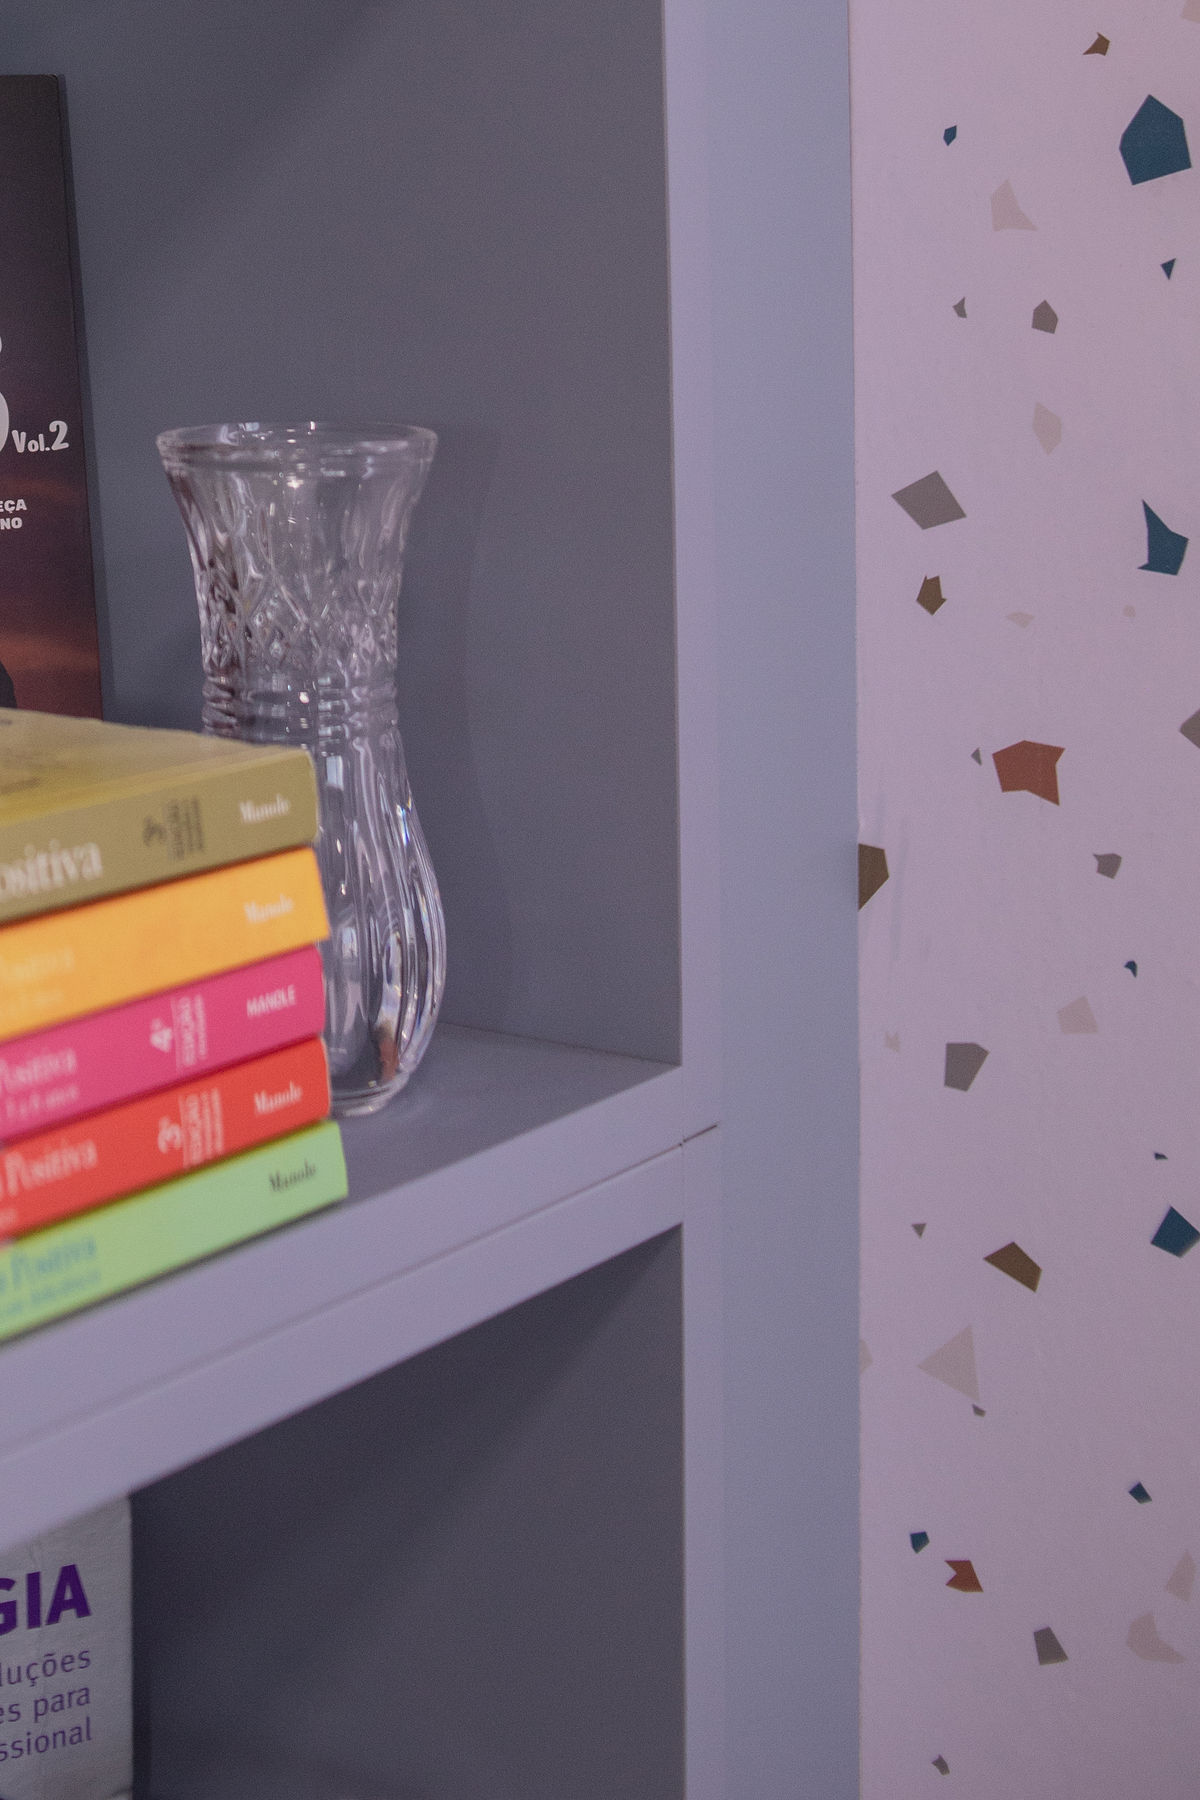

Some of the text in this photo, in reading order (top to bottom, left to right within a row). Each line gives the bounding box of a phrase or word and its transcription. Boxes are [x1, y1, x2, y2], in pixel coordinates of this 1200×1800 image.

[11, 420, 70, 453] Vol.2
[238, 793, 292, 824] Manole
[243, 893, 295, 925] Manole
[246, 984, 296, 1017] MANOLE
[254, 1080, 304, 1116] Manole
[4, 1137, 98, 1198] Positiva
[267, 1157, 318, 1194] Manole
[33, 1686, 91, 1724] para
